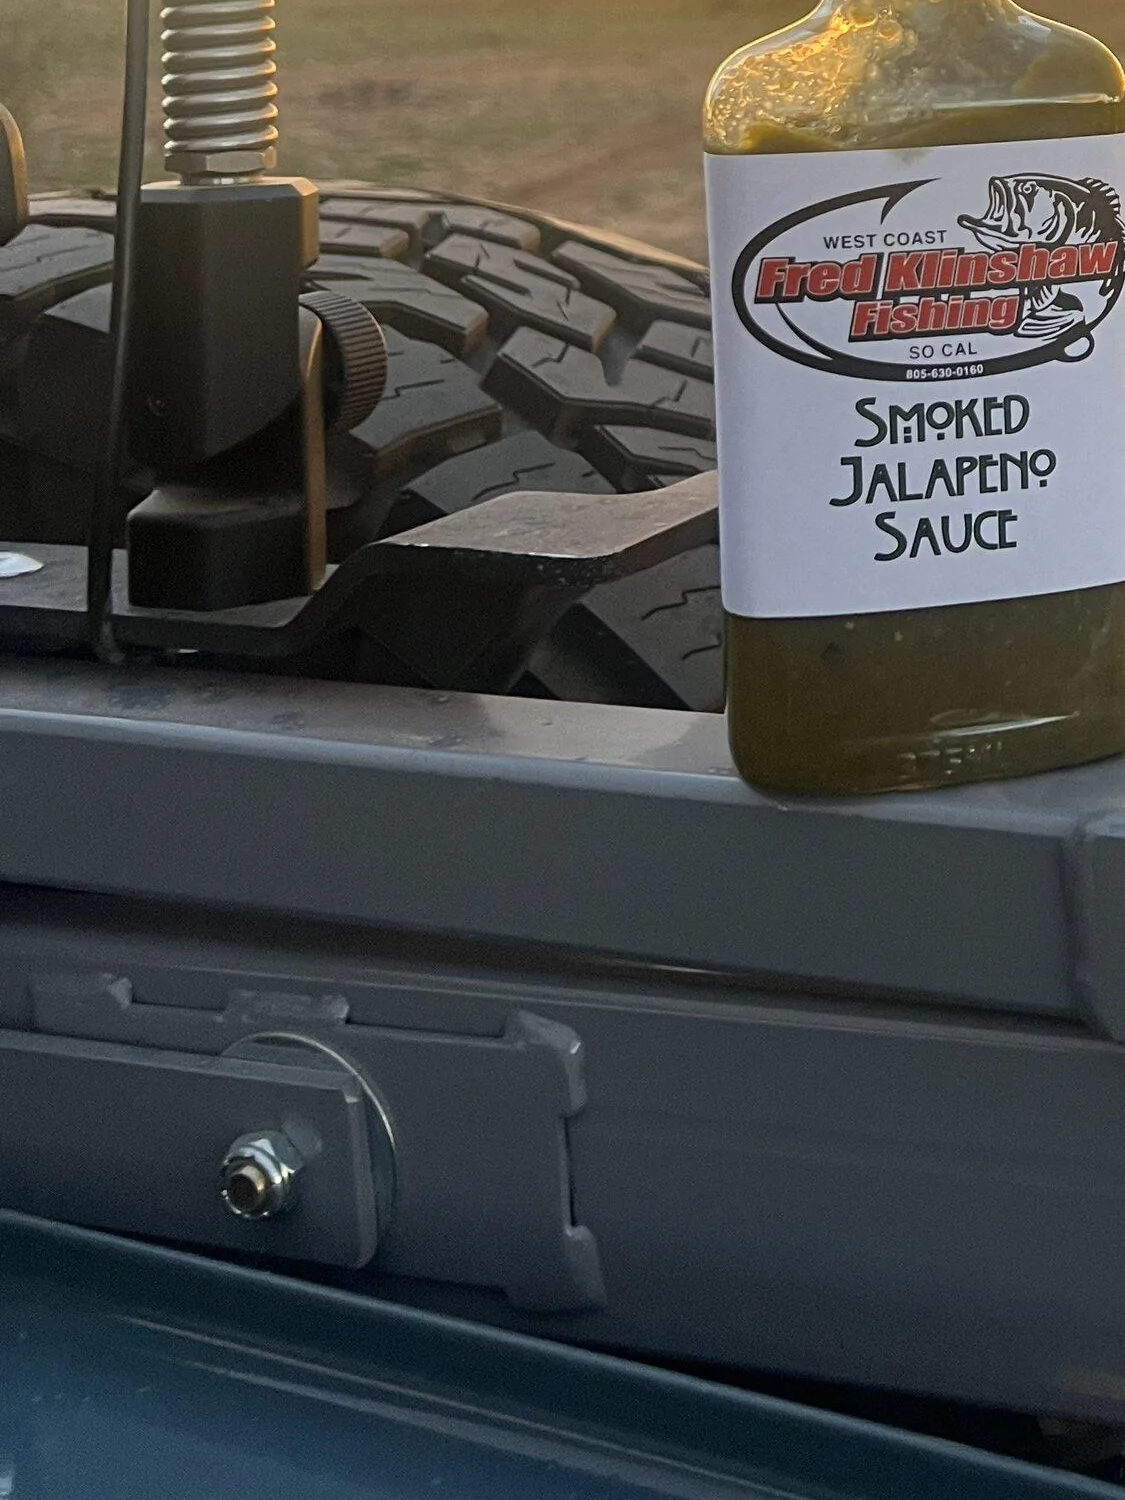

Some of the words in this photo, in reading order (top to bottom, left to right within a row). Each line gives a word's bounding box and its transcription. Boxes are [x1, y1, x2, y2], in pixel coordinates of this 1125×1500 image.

[823, 233, 877, 250] WEST
[884, 229, 948, 247] COAST
[755, 252, 879, 302] Fred
[884, 239, 1119, 294] Klinshaw
[849, 293, 1022, 341] Fishing
[906, 364, 984, 379] 805-630-0160
[909, 345, 935, 360] SO
[941, 342, 978, 357] CAL
[854, 394, 1030, 447] SMOKED
[874, 509, 1018, 562] SAUCE
